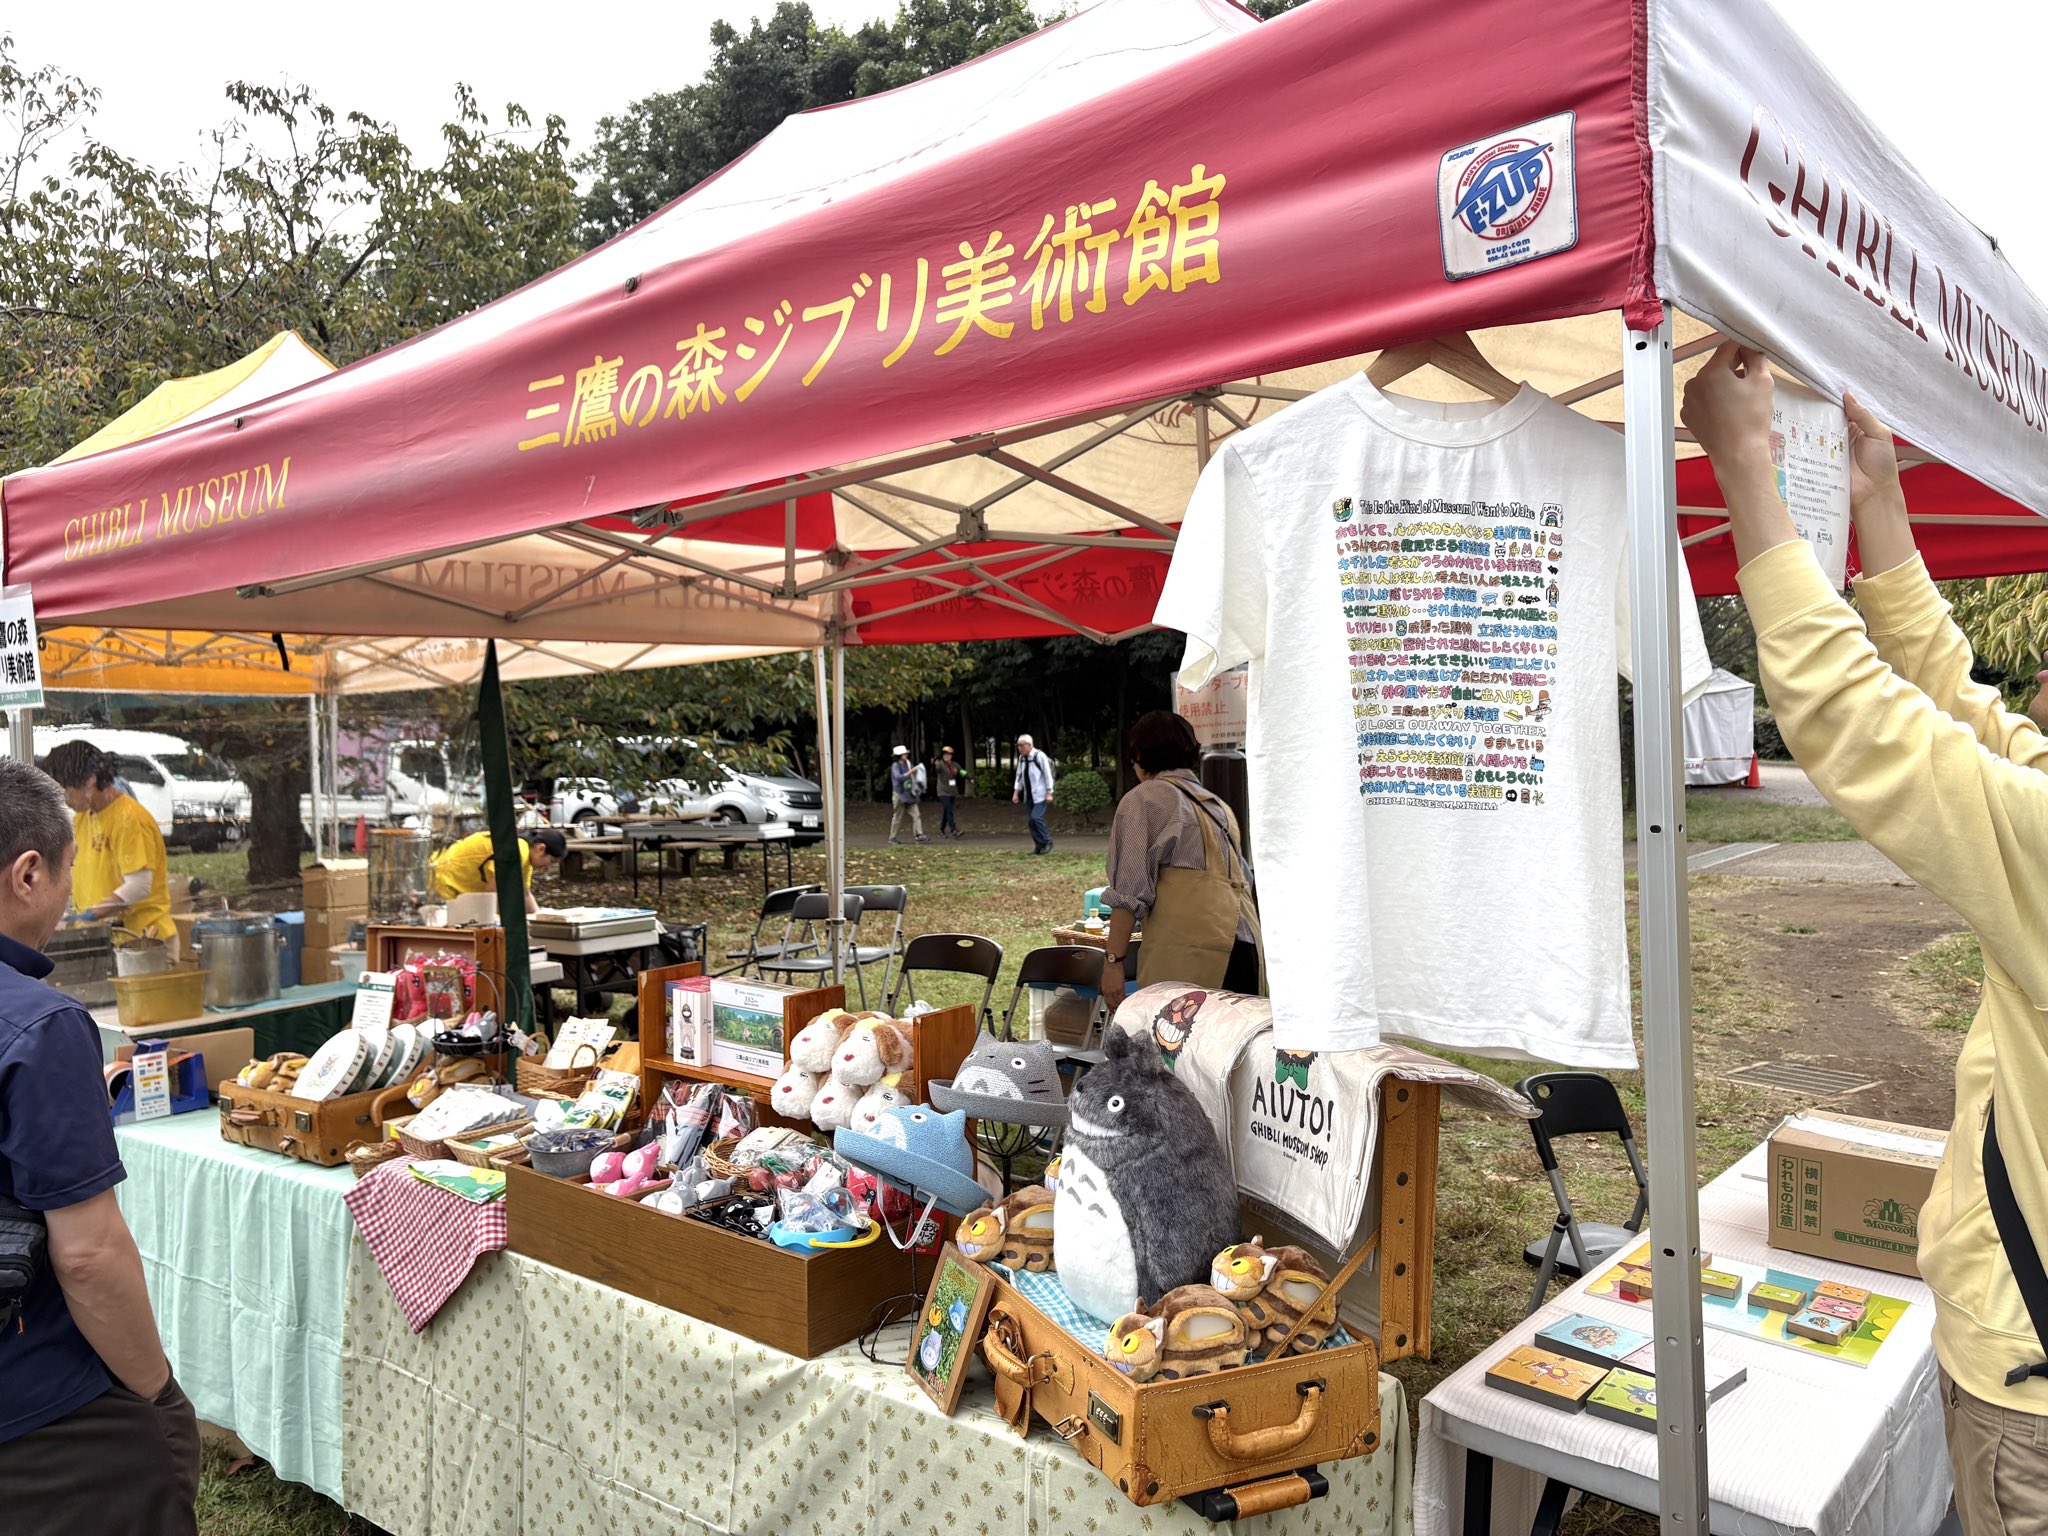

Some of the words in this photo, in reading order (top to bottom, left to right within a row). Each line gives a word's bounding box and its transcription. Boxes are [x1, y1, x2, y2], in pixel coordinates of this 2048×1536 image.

[1495, 215, 1532, 236] ORIGINAL
[1530, 186, 1548, 213] SHADE
[1486, 238, 1531, 255] ezup.com
[1509, 246, 1530, 257] SHADE
[517, 163, 1228, 452] 三鷹の森ジブリ美術館
[63, 498, 149, 562] GHIBLI
[154, 455, 292, 540] MUSEUM
[1373, 499, 1384, 514] Is
[1383, 499, 1400, 514] the
[1399, 499, 1423, 514] Kind
[1422, 498, 1433, 514] of
[1432, 498, 1472, 515] Museum
[1475, 502, 1500, 518] Want
[1500, 503, 1509, 518] to
[1509, 502, 1536, 520] Make
[1180, 701, 1228, 718] 使用禁止
[1368, 720, 1405, 731] LOSE
[1408, 720, 1437, 731] OUR
[1438, 720, 1471, 732] WAY
[1484, 735, 1545, 753] すましている
[1474, 768, 1544, 786] おもしろくない
[1365, 796, 1406, 806] GHIBLI
[1252, 1076, 1335, 1143] AIUTO!
[1250, 1120, 1281, 1145] GHIBLI
[1282, 1131, 1310, 1159] MUSEUM
[1309, 1144, 1329, 1172] SHOP
[1779, 1157, 1795, 1228] われもの注意
[1803, 1166, 1820, 1229] 横倒厳禁
[1845, 1233, 1863, 1244] The
[1862, 1237, 1884, 1248] Gift
[1883, 1240, 1893, 1250] of
